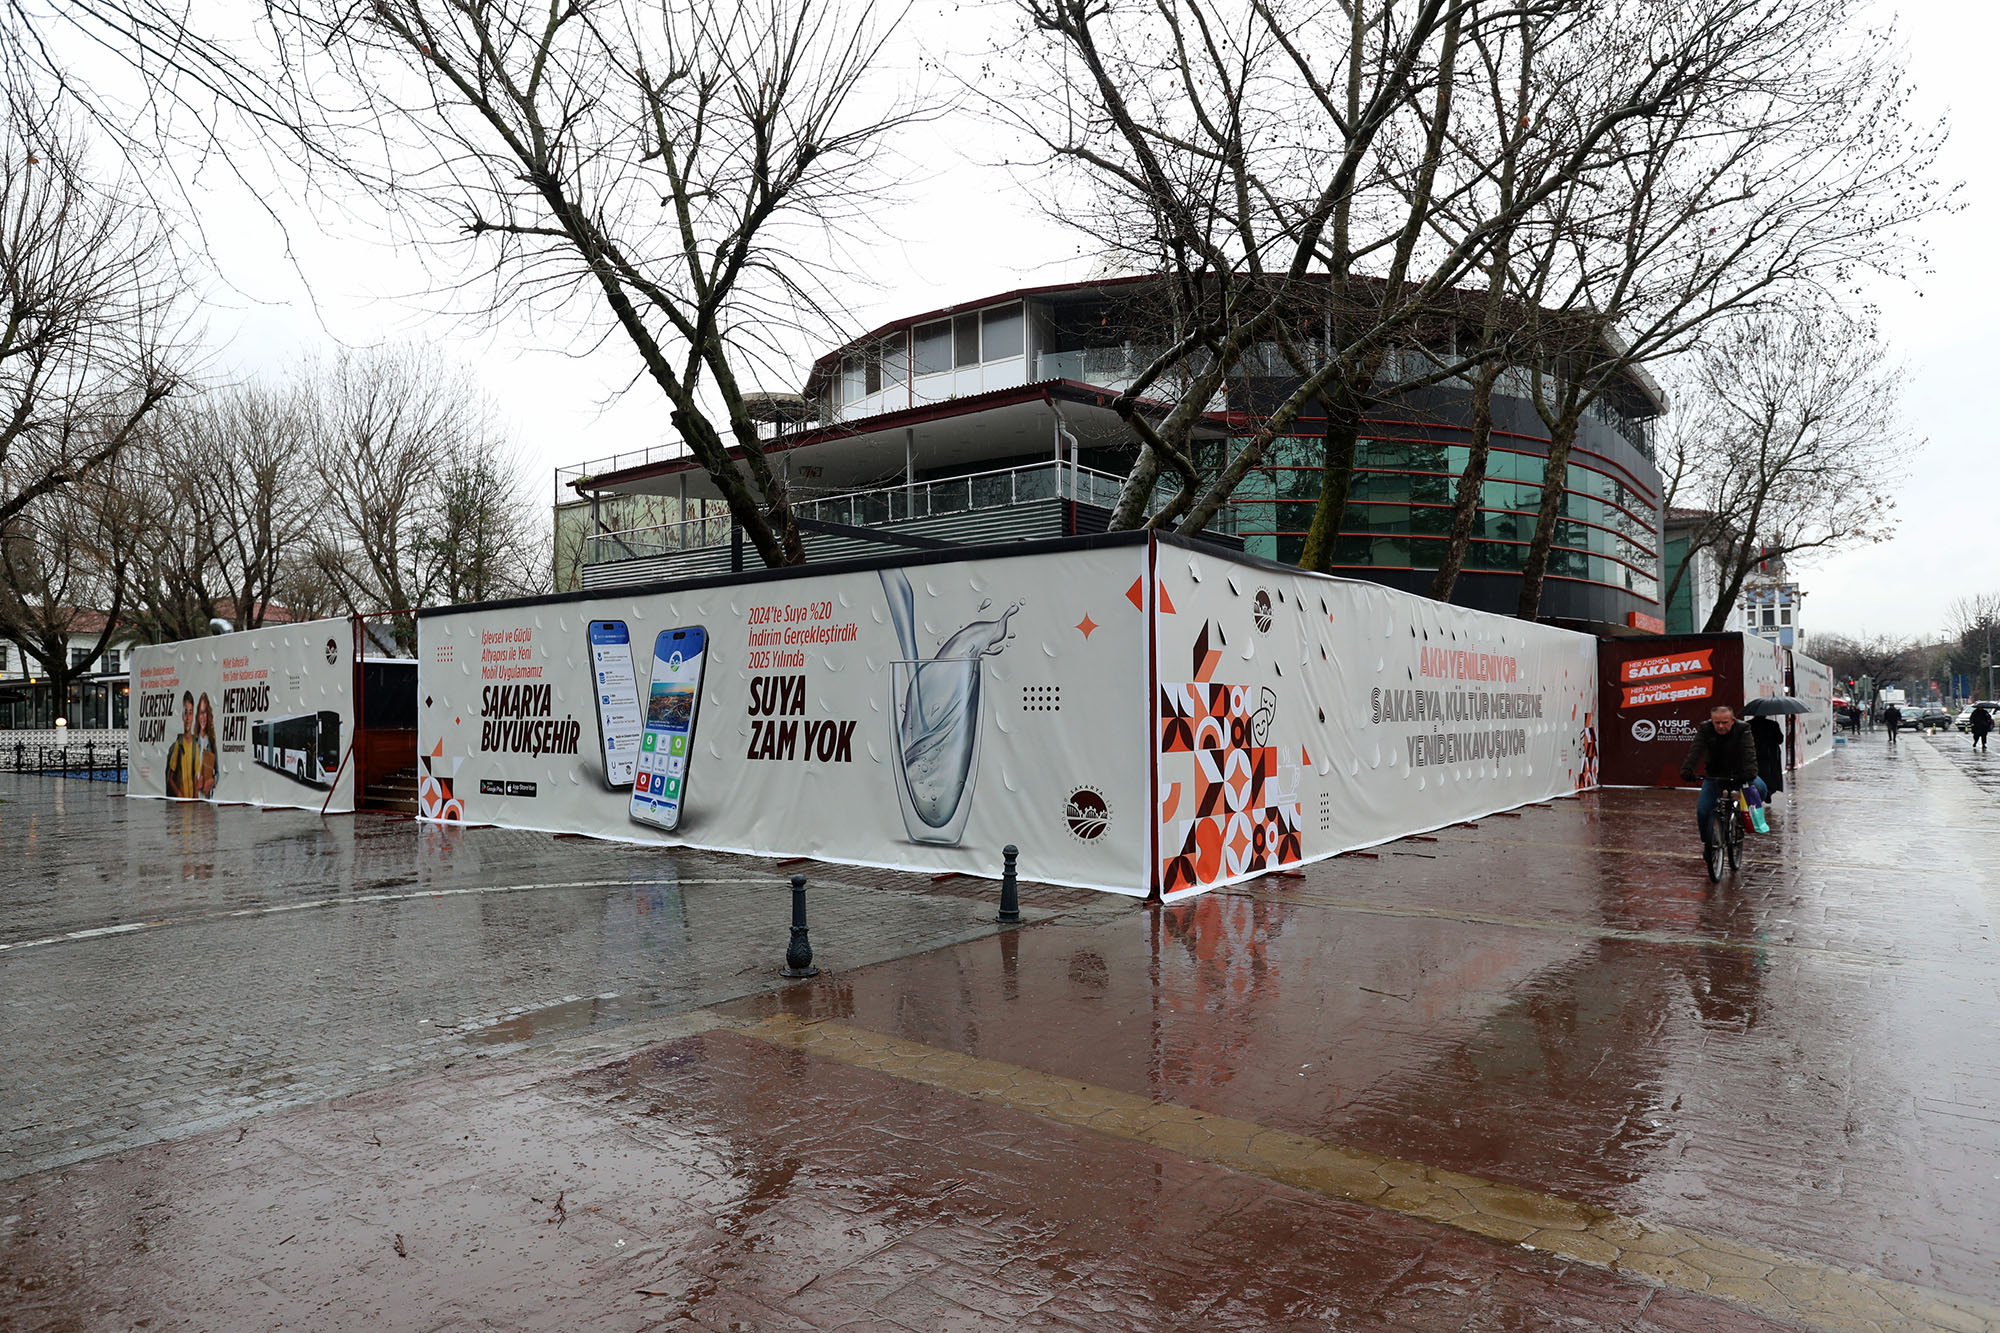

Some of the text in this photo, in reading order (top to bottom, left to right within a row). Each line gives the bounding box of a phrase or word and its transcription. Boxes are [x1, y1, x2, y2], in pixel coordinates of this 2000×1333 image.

[748, 601, 832, 625] 2024'te Suya %20
[481, 628, 532, 646] İşlevsel ve Güçlü
[748, 622, 858, 647] İndirim Gerçekleştirdik
[481, 645, 532, 663] Altyapısı ile Yeni
[748, 650, 804, 669] 2025 Yılında
[1420, 643, 1517, 683] AKM YENİLENİYOR
[1643, 658, 1670, 667] ADIMDA
[481, 664, 543, 681] Mobil Uygulamamız
[1628, 659, 1702, 679] SAKARYA
[222, 681, 270, 714] METROBÜS
[481, 683, 551, 718] SAKARYA
[748, 675, 806, 716] SUYA
[1629, 686, 1707, 704] BÜYÜKŞEHİR
[1630, 684, 1671, 695] HER ADIMDA
[139, 689, 174, 718] ÜCRETSİZ
[1371, 687, 1444, 725] SAKARYA,
[1446, 685, 1490, 722] KÜLTÜR
[138, 720, 166, 746] ULAŞIM
[222, 716, 248, 742] HATTI
[481, 713, 580, 759] BÜYÜKŞEHİR
[1657, 719, 1690, 728] YUSUF
[1657, 727, 1698, 735] ALEMDA
[747, 719, 857, 762] ZAM YOK
[1406, 724, 1526, 768] YENİDEN KAVUŞUYOR
